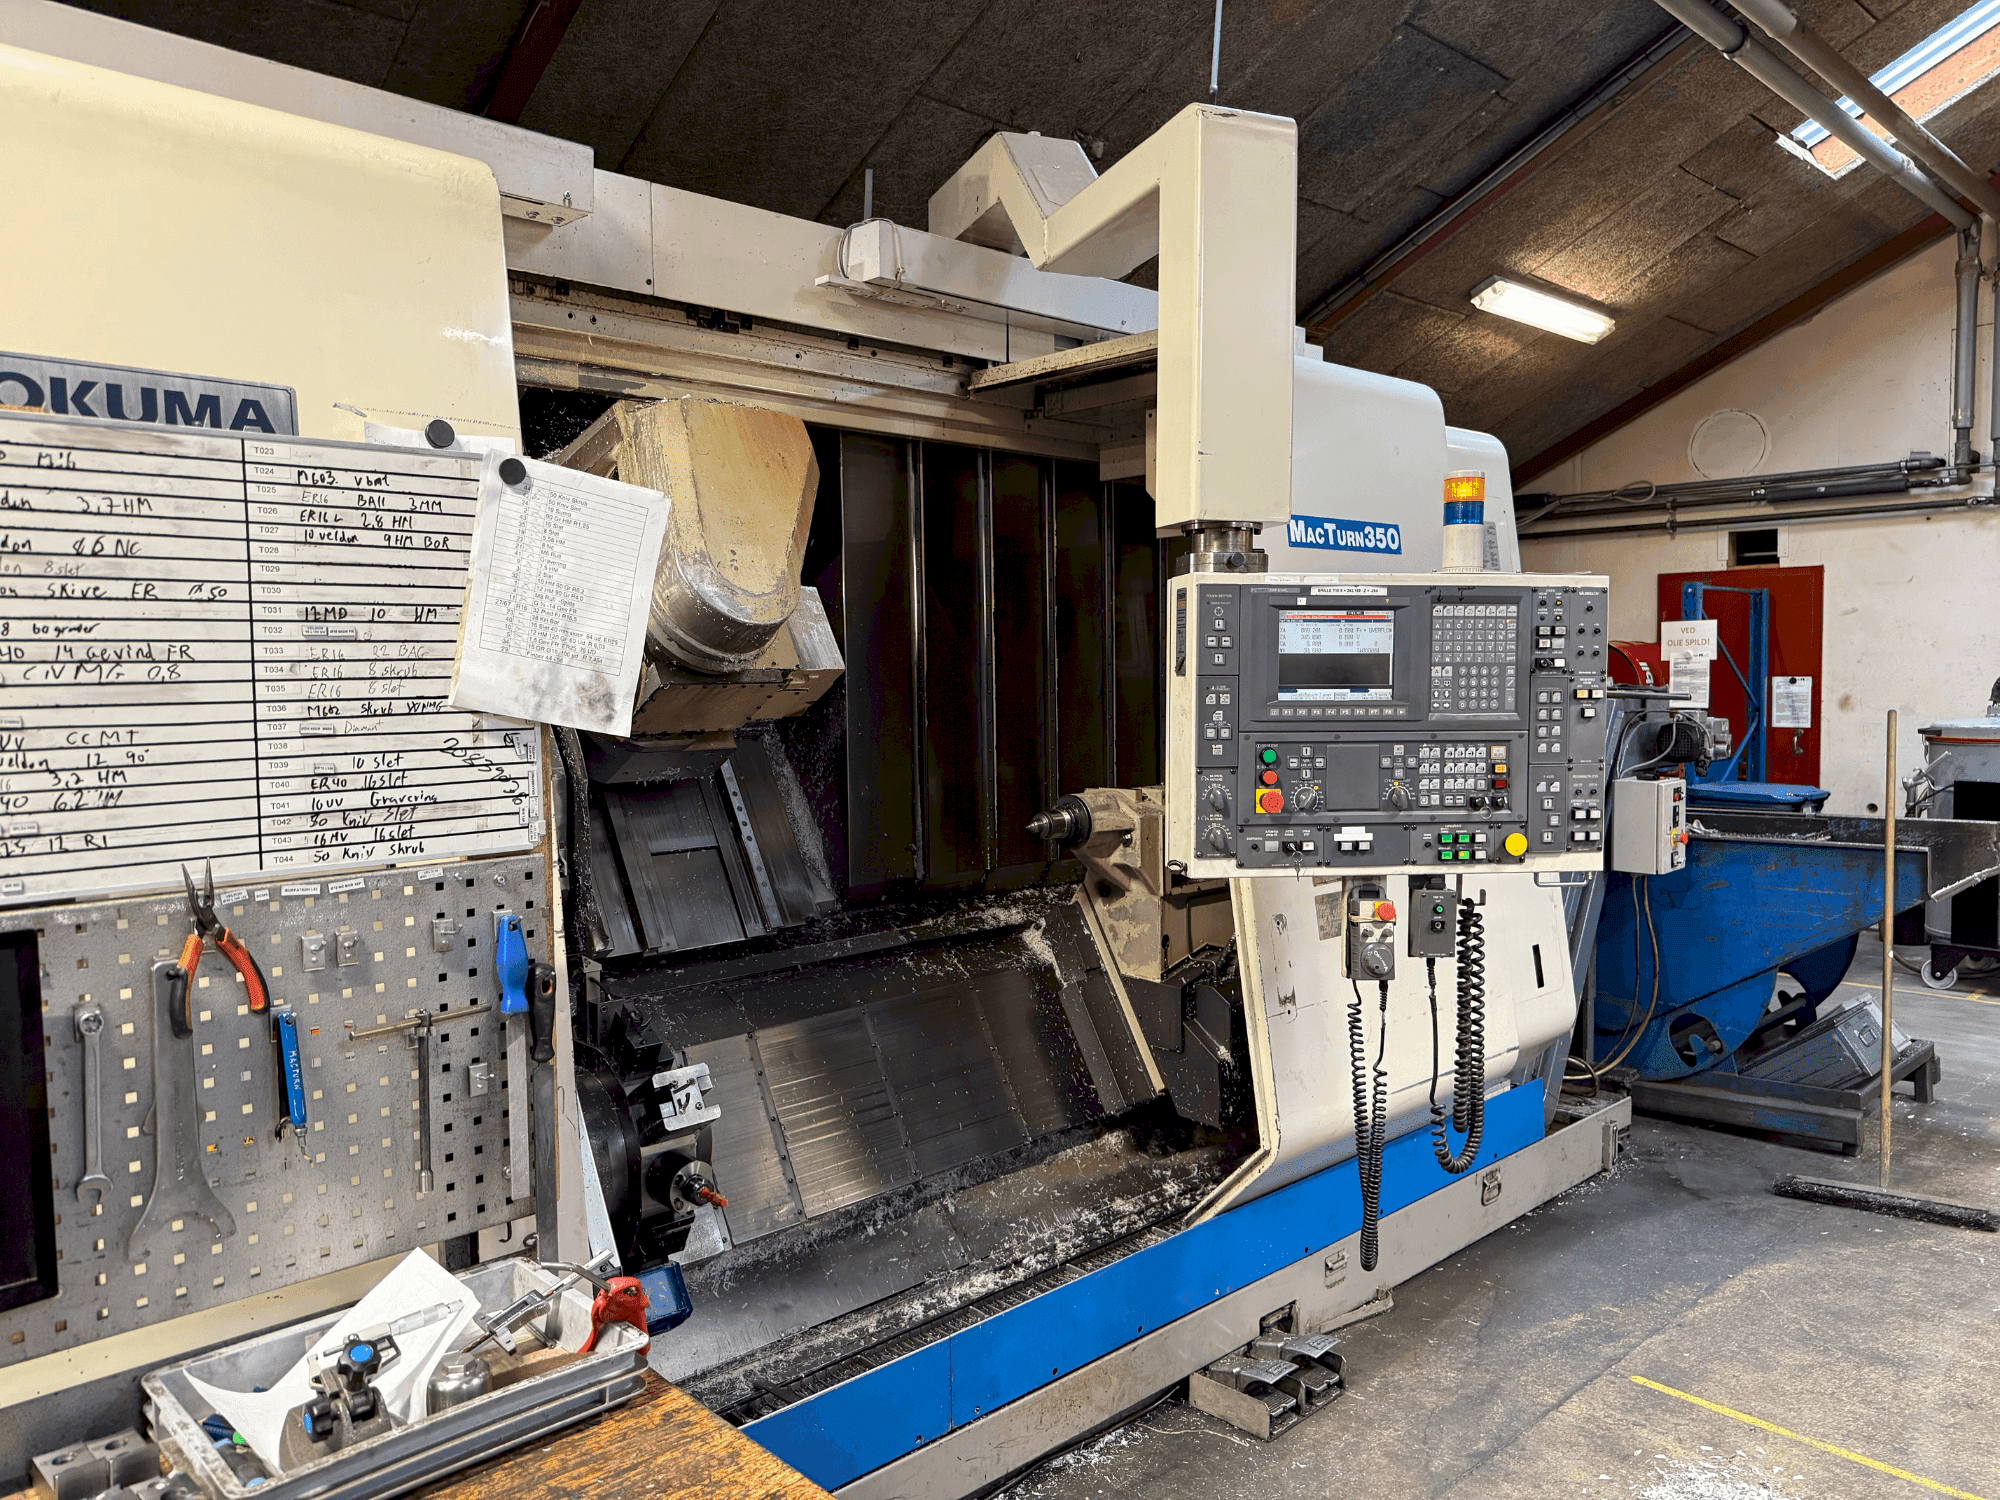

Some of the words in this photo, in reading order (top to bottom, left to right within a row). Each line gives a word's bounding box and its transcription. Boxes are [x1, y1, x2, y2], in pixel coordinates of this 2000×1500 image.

[254, 446, 274, 454] T023
[254, 466, 274, 475] T024
[257, 485, 276, 494] T025
[257, 506, 277, 515] T026
[259, 525, 279, 534] T027
[259, 545, 279, 554] T028
[260, 564, 280, 573] T029
[261, 585, 281, 595] T030
[262, 605, 282, 614] T031
[262, 626, 282, 635] T032
[263, 646, 283, 655] T033
[264, 665, 283, 674] T034
[265, 684, 285, 694] T035
[267, 704, 286, 713] T036
[267, 723, 286, 732] T037
[268, 741, 287, 751] T038
[269, 760, 288, 769] T039
[270, 780, 289, 789] T040
[270, 801, 289, 810] T041
[271, 817, 291, 826] T042
[272, 836, 292, 845] T043
[274, 854, 293, 864] T044
